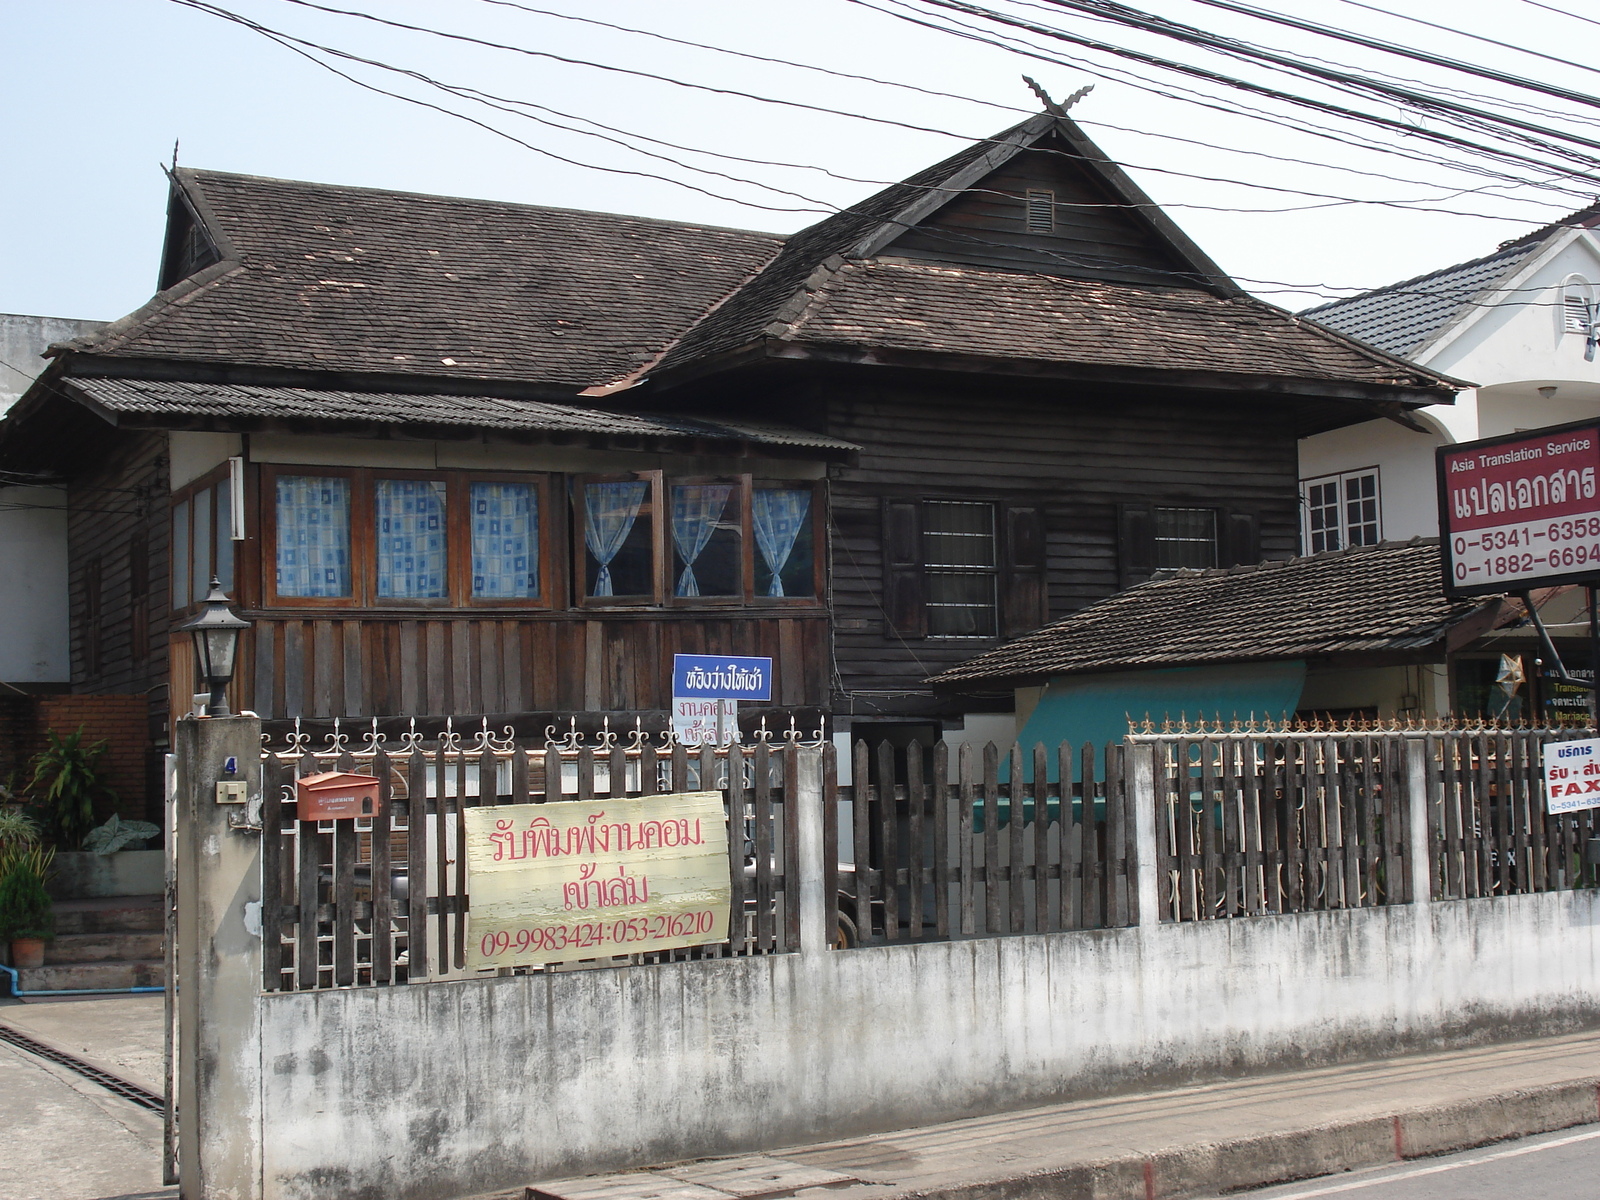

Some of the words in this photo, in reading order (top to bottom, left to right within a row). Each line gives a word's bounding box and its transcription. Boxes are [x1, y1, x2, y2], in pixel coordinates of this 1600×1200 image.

[1451, 459, 1475, 473] Asia
[1479, 447, 1542, 468] Translation
[1547, 439, 1591, 456] Service
[1454, 467, 1597, 519] แปลเอกสาร
[1454, 517, 1600, 555] 0-5341-6358
[1455, 543, 1600, 580] 0-1882-6694
[686, 664, 763, 691] ห้องว่างให้เช่า
[225, 757, 237, 774] 4
[1558, 745, 1593, 758] บริการ
[1549, 765, 1569, 781] รับ
[1550, 779, 1600, 798] FAX
[489, 811, 706, 862] รับพิมพ์งานคอม.
[563, 863, 648, 911] เข้าเล่ม
[481, 910, 714, 957] 09-9983424:053-216210
